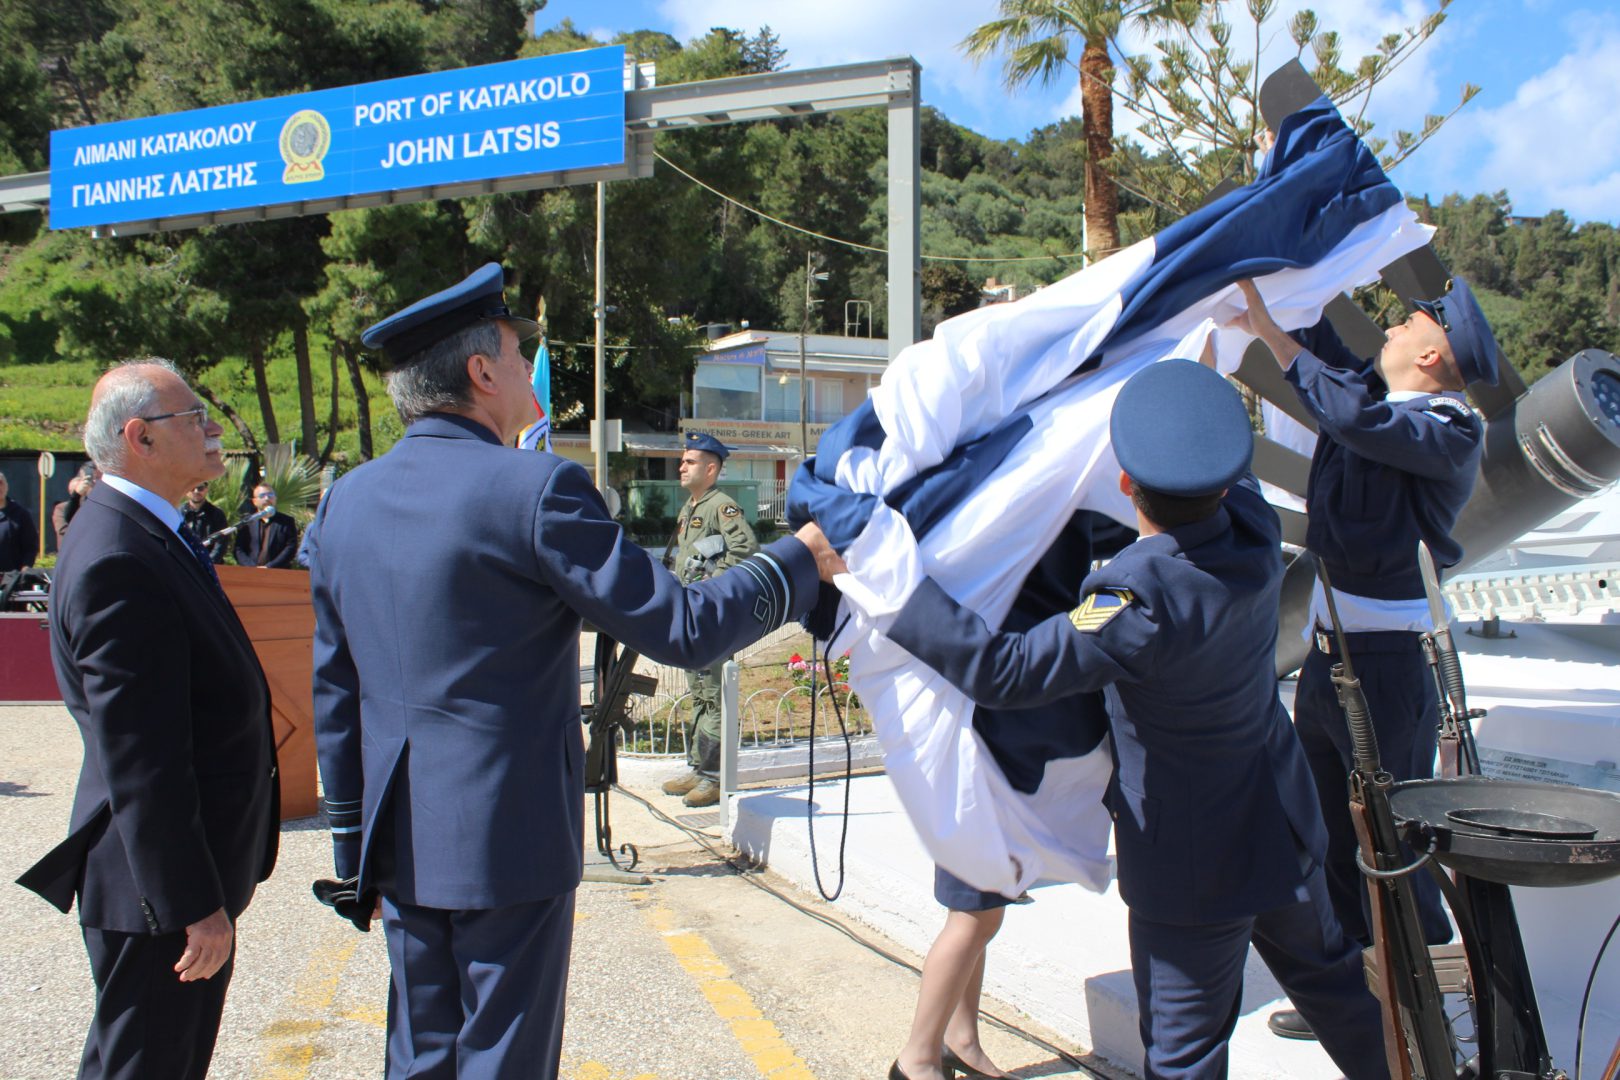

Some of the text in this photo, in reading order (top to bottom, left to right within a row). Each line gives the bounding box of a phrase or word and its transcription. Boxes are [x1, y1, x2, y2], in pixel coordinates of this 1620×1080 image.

[355, 72, 590, 127] PORT OF KATAKOLO
[73, 139, 137, 167] ΛΙΜΑΝΙ
[141, 121, 257, 157] ΚΑΤΑΚΟΛΟΥ
[381, 121, 560, 169] JOHN LATSIS
[72, 161, 257, 208] ΓΙΑΝΝΗΣ ΛΑΤΣΗΣ
[742, 430, 772, 439] GREEK
[774, 431, 791, 440] ART
